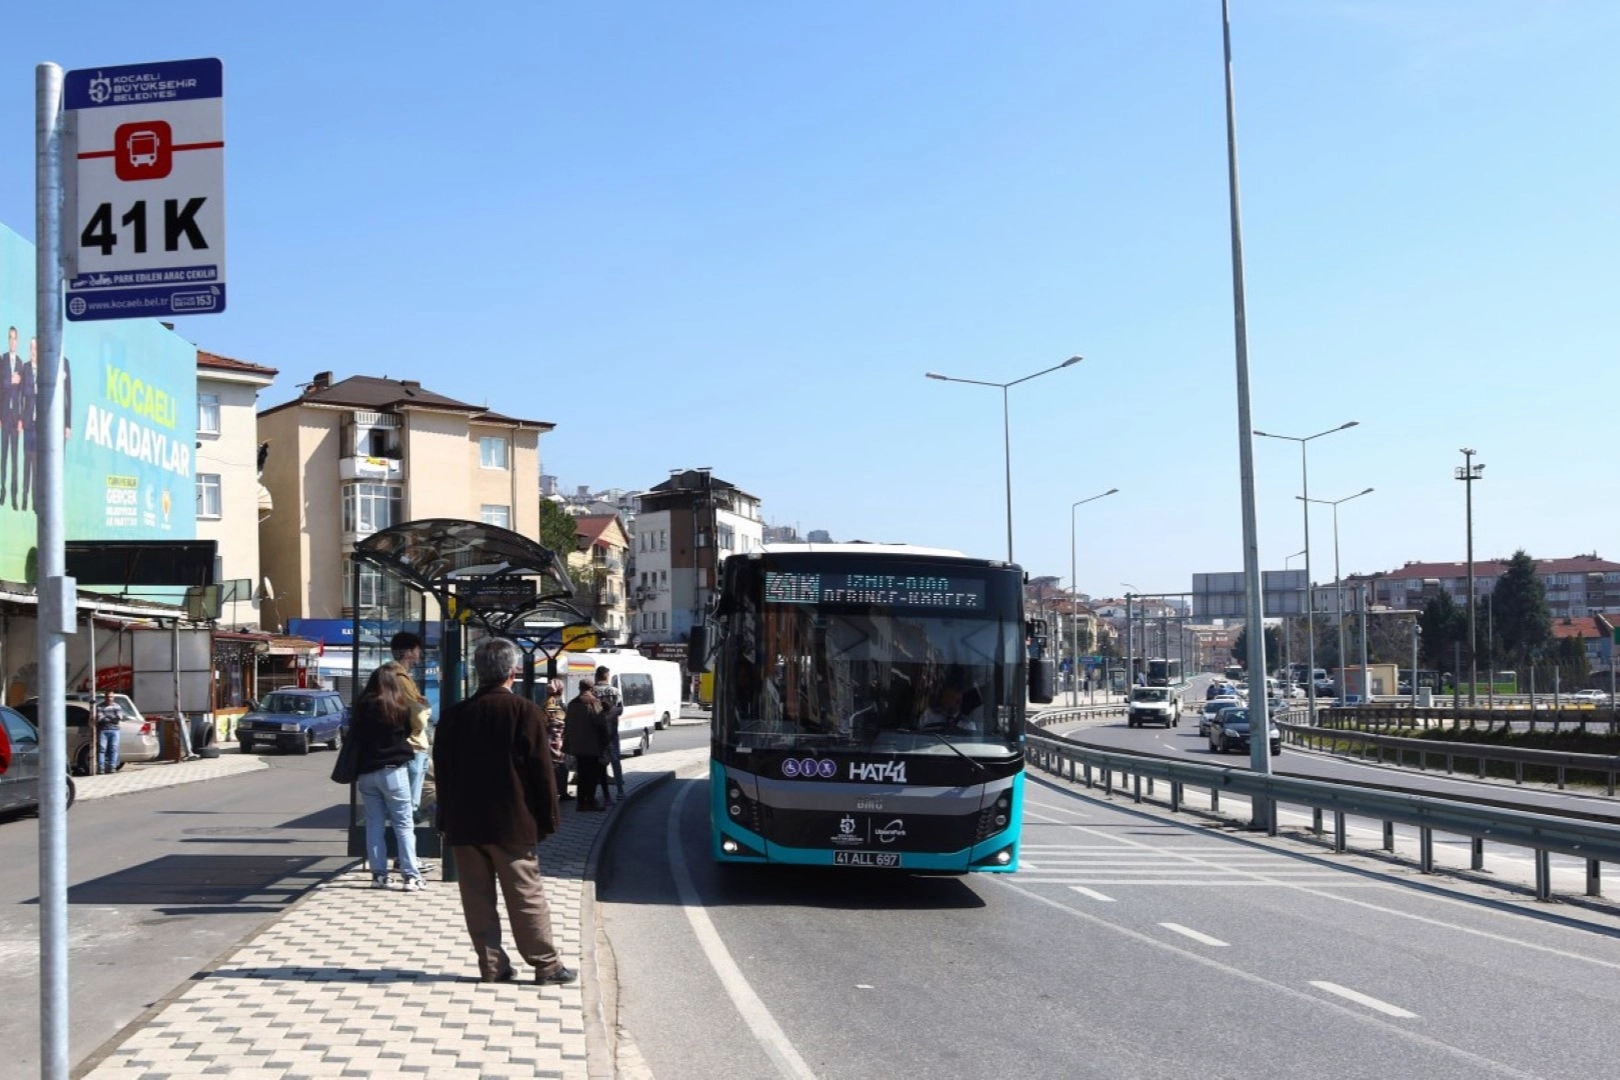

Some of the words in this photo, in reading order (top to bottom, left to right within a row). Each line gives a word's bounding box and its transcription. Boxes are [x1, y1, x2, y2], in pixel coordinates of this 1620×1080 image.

[113, 274, 134, 284] PARK
[195, 294, 212, 306] 153
[84, 403, 114, 450] AK
[116, 417, 190, 478] ADAYLAR
[836, 853, 849, 864] 41
[851, 853, 873, 865] ALL
[876, 854, 897, 866] 697
